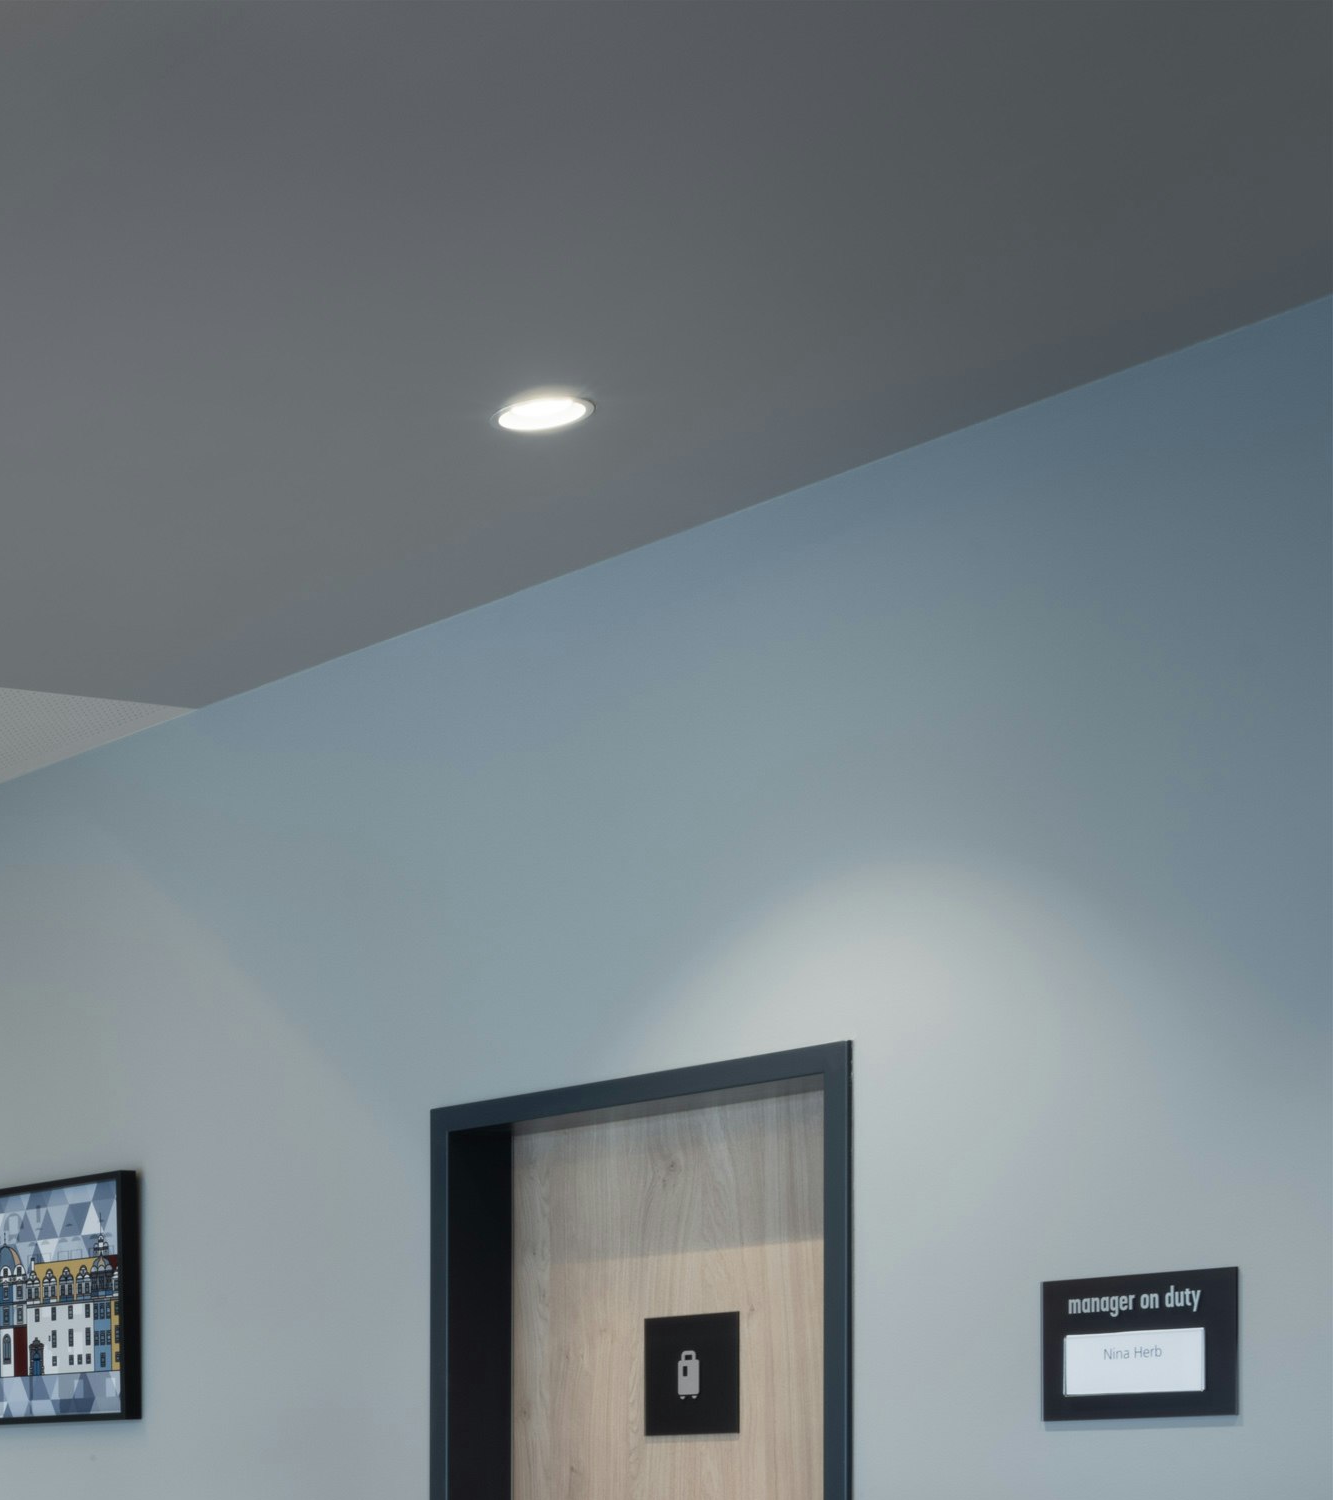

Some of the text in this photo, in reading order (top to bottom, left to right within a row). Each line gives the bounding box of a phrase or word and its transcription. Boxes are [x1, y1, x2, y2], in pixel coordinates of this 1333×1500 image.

[1068, 1285, 1201, 1317] manager on duty
[1103, 1344, 1163, 1361] Nina Herb
